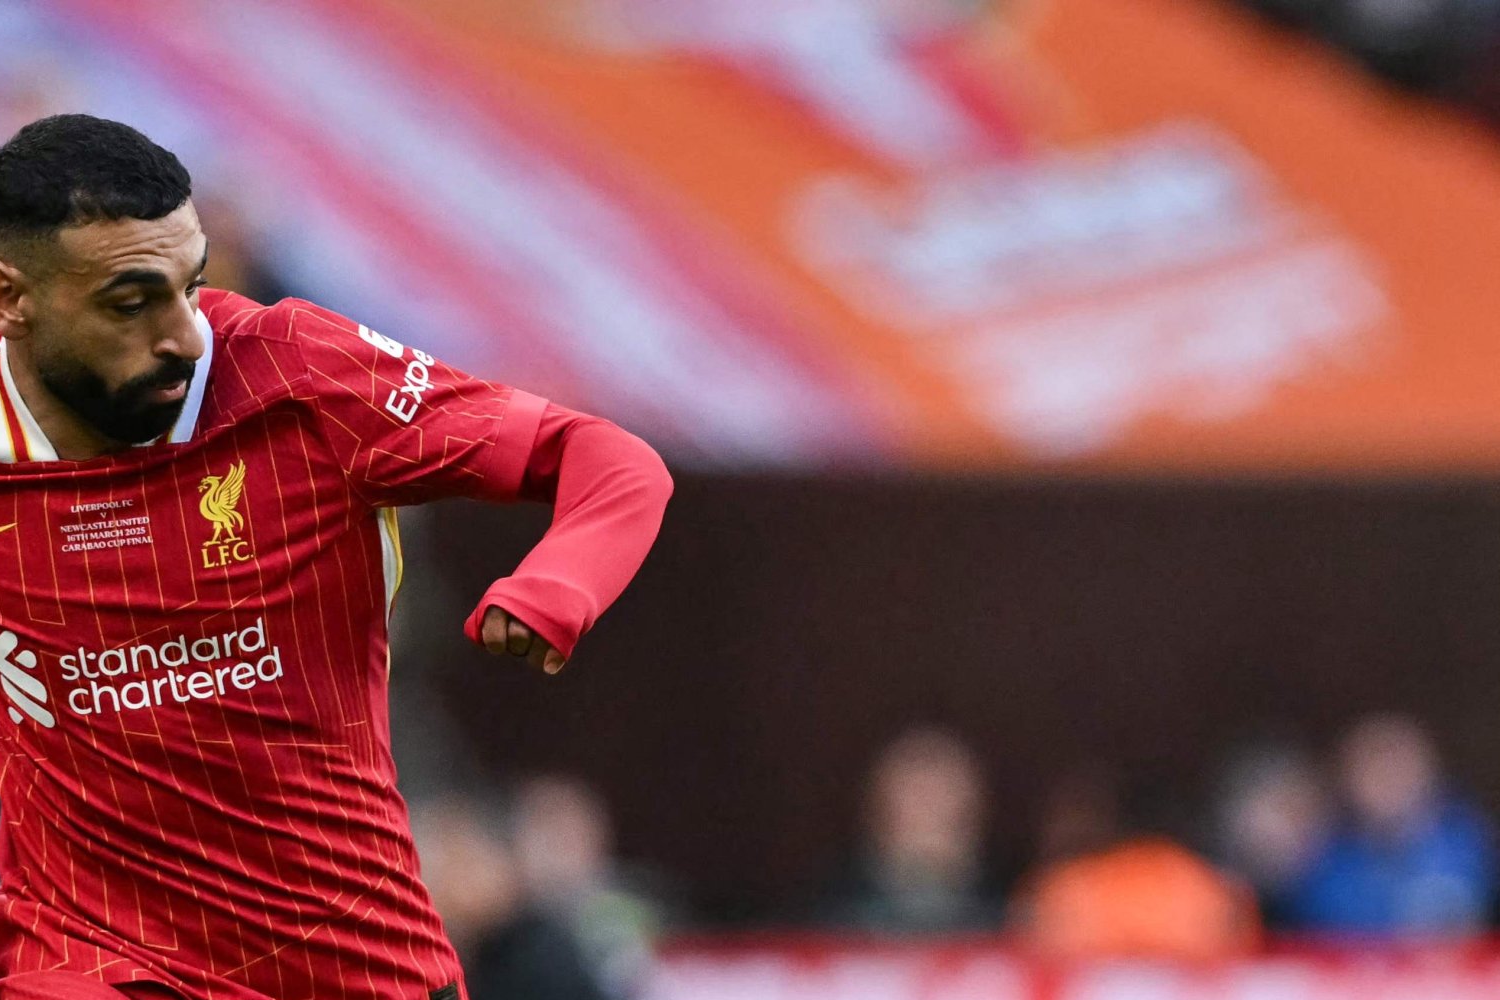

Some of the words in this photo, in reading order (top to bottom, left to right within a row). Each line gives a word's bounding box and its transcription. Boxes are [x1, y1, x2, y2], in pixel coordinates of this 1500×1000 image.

[70, 501, 122, 513] LIVERPOOL
[122, 499, 134, 507] FC
[60, 520, 116, 533] NEWCASTLE
[116, 516, 150, 527] UNITED
[66, 532, 89, 542] 16TH
[89, 529, 123, 540] MARCH
[125, 526, 146, 536] 2025
[61, 541, 106, 552] CARABAO
[107, 538, 126, 548] CUP
[126, 535, 153, 546] FINAL
[59, 616, 266, 681] standard
[68, 646, 284, 715] chartered
